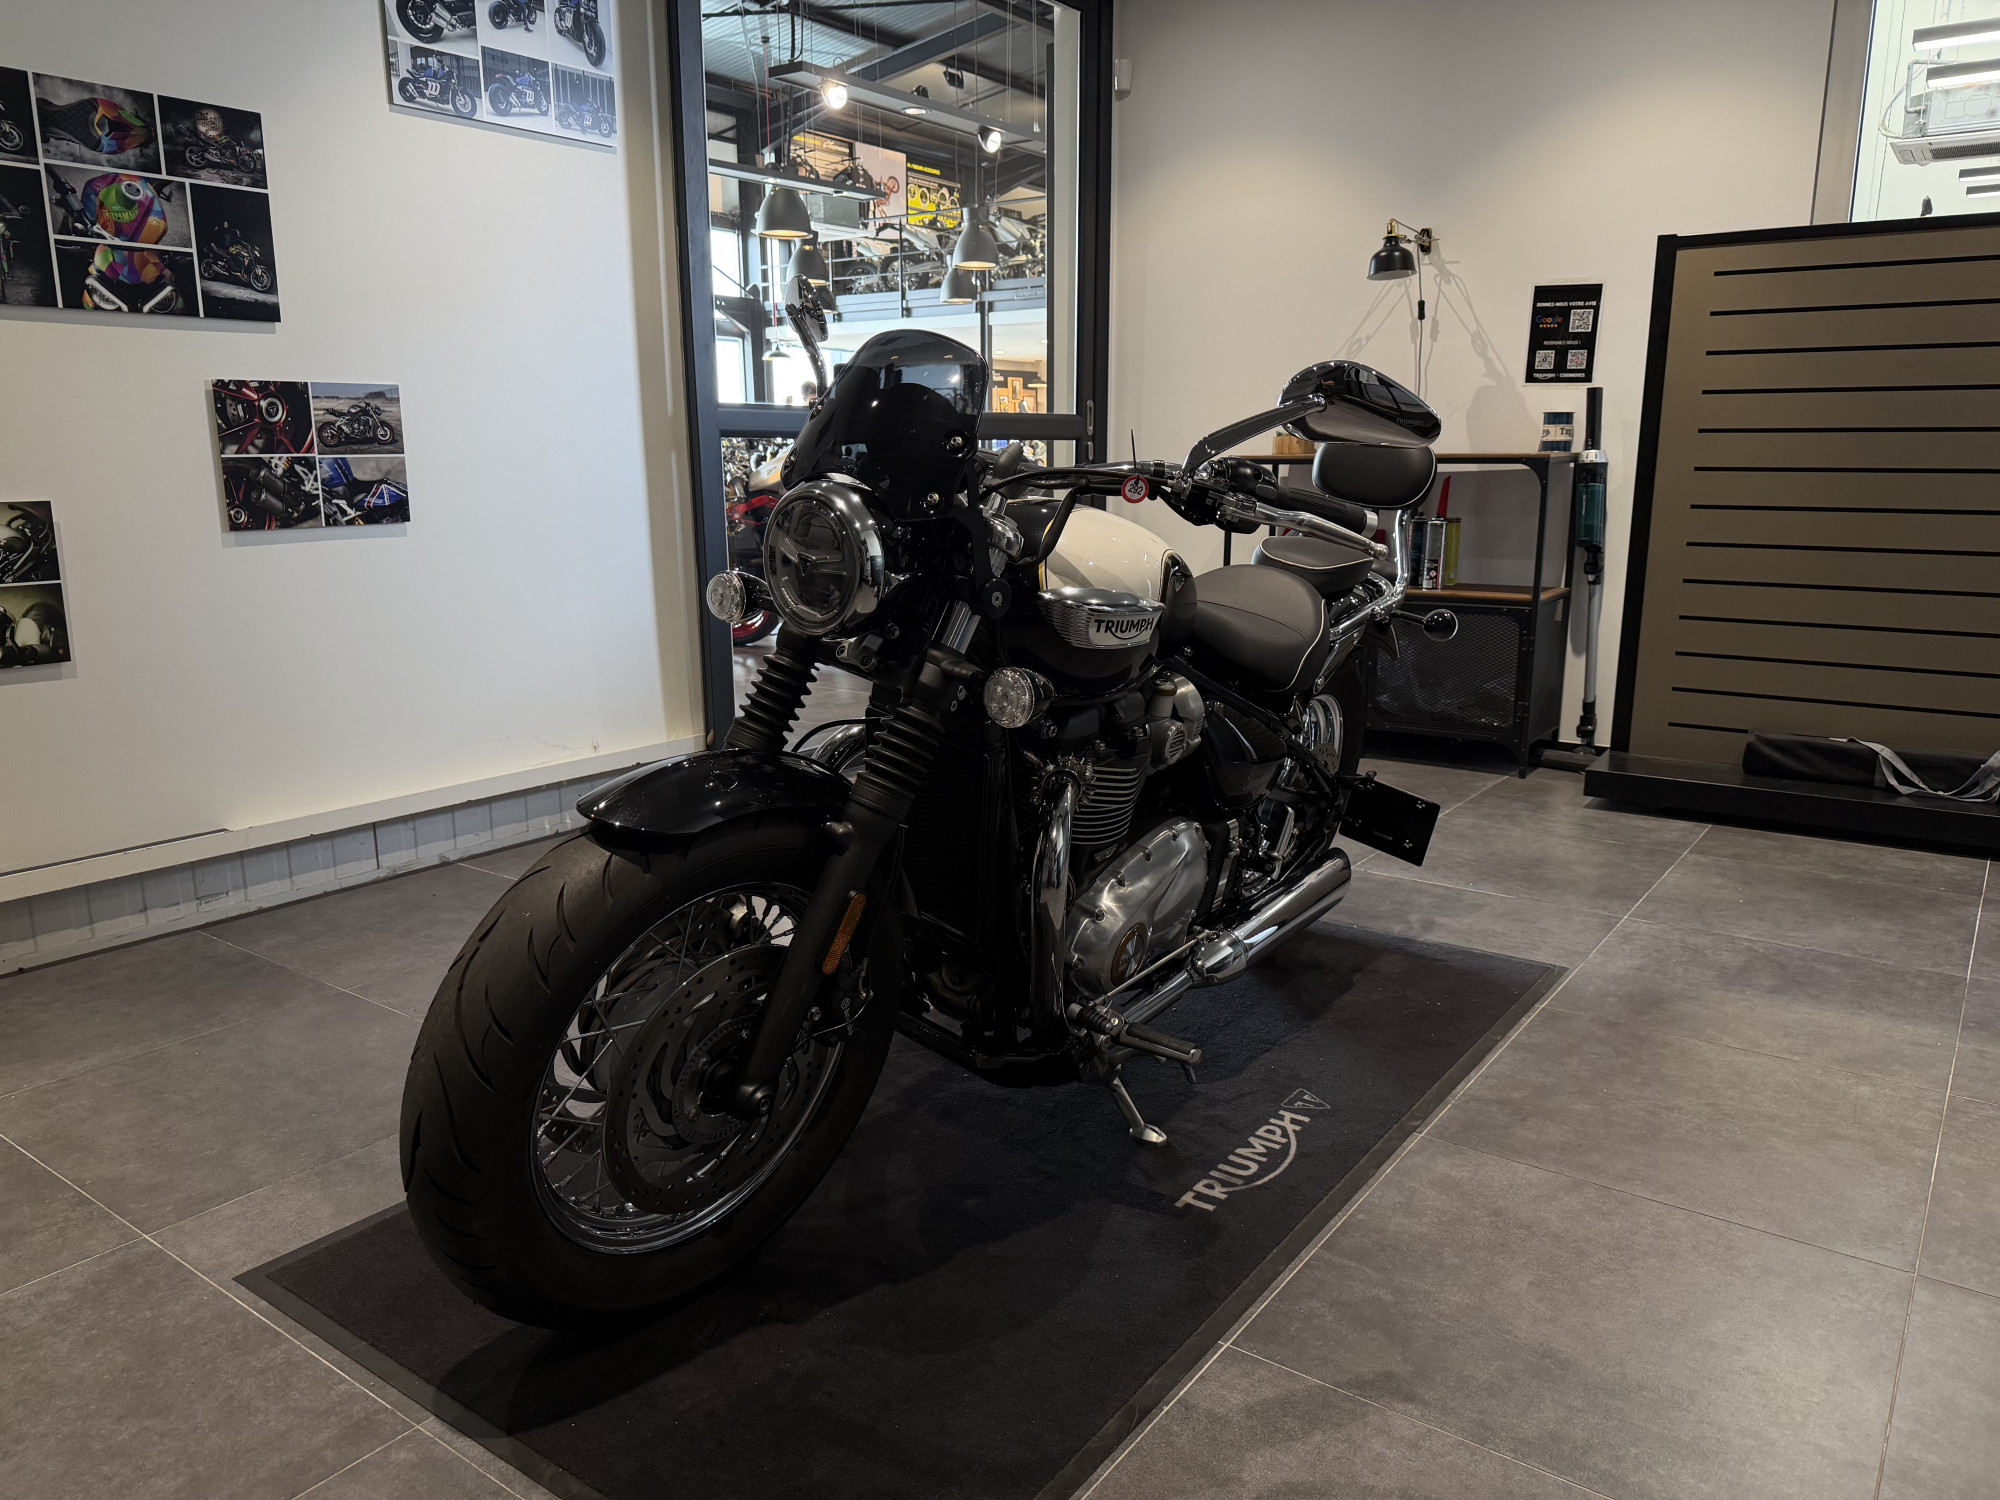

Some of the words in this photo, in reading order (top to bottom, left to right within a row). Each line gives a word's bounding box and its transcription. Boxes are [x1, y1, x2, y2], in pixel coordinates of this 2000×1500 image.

[1535, 315, 1563, 324] Google
[1128, 483, 1144, 496] 292
[1094, 617, 1155, 639] TRIUMPH
[1174, 1109, 1311, 1212] TRIUMPH
